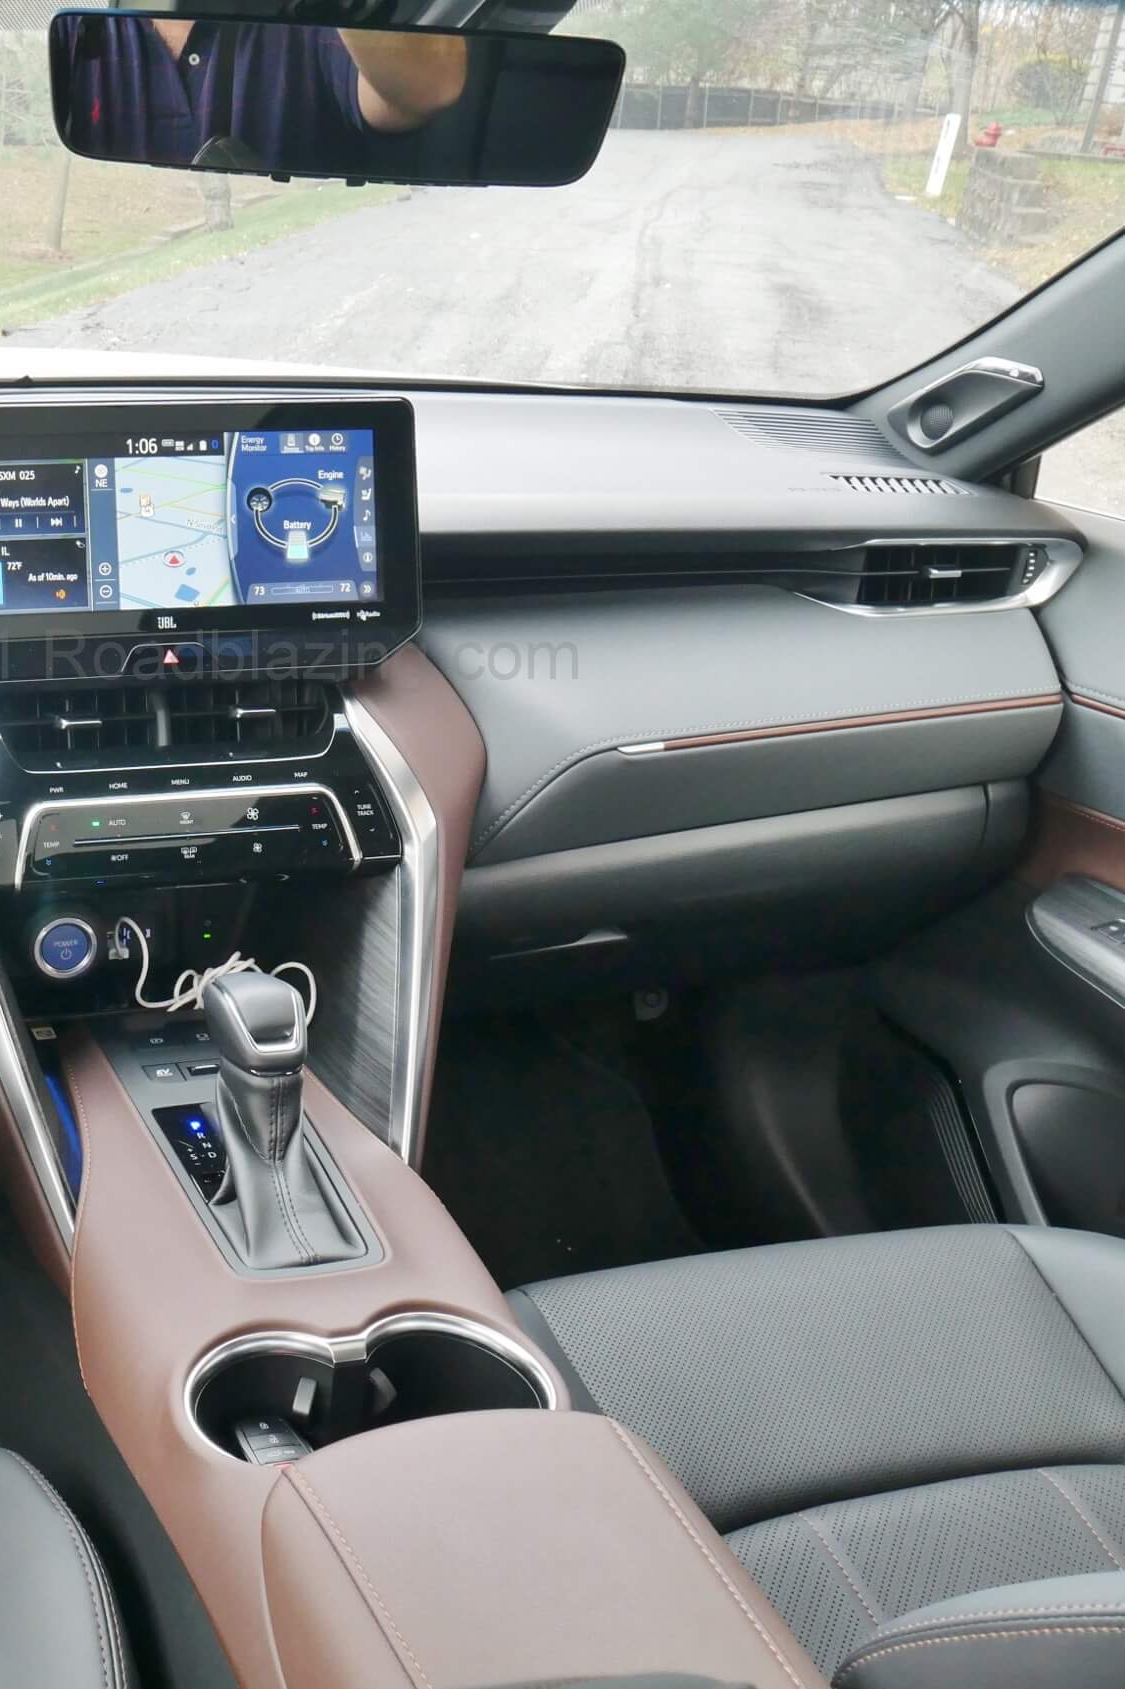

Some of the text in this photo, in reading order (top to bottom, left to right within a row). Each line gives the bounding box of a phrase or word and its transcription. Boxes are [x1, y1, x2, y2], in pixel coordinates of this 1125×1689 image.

[241, 435, 264, 444] Energy
[125, 438, 158, 455] 1:06
[19, 471, 35, 480] 025
[317, 470, 344, 480] Engine
[95, 479, 108, 488] NE
[0, 498, 19, 508] Ways
[20, 497, 46, 508] (Worlds
[48, 496, 70, 507] Apart)
[283, 520, 312, 530] Battery
[27, 573, 37, 582] As
[38, 573, 44, 581] of
[254, 586, 266, 596] 73
[340, 583, 351, 593] 72
[157, 616, 177, 629] JBL
[109, 782, 128, 790] HOME
